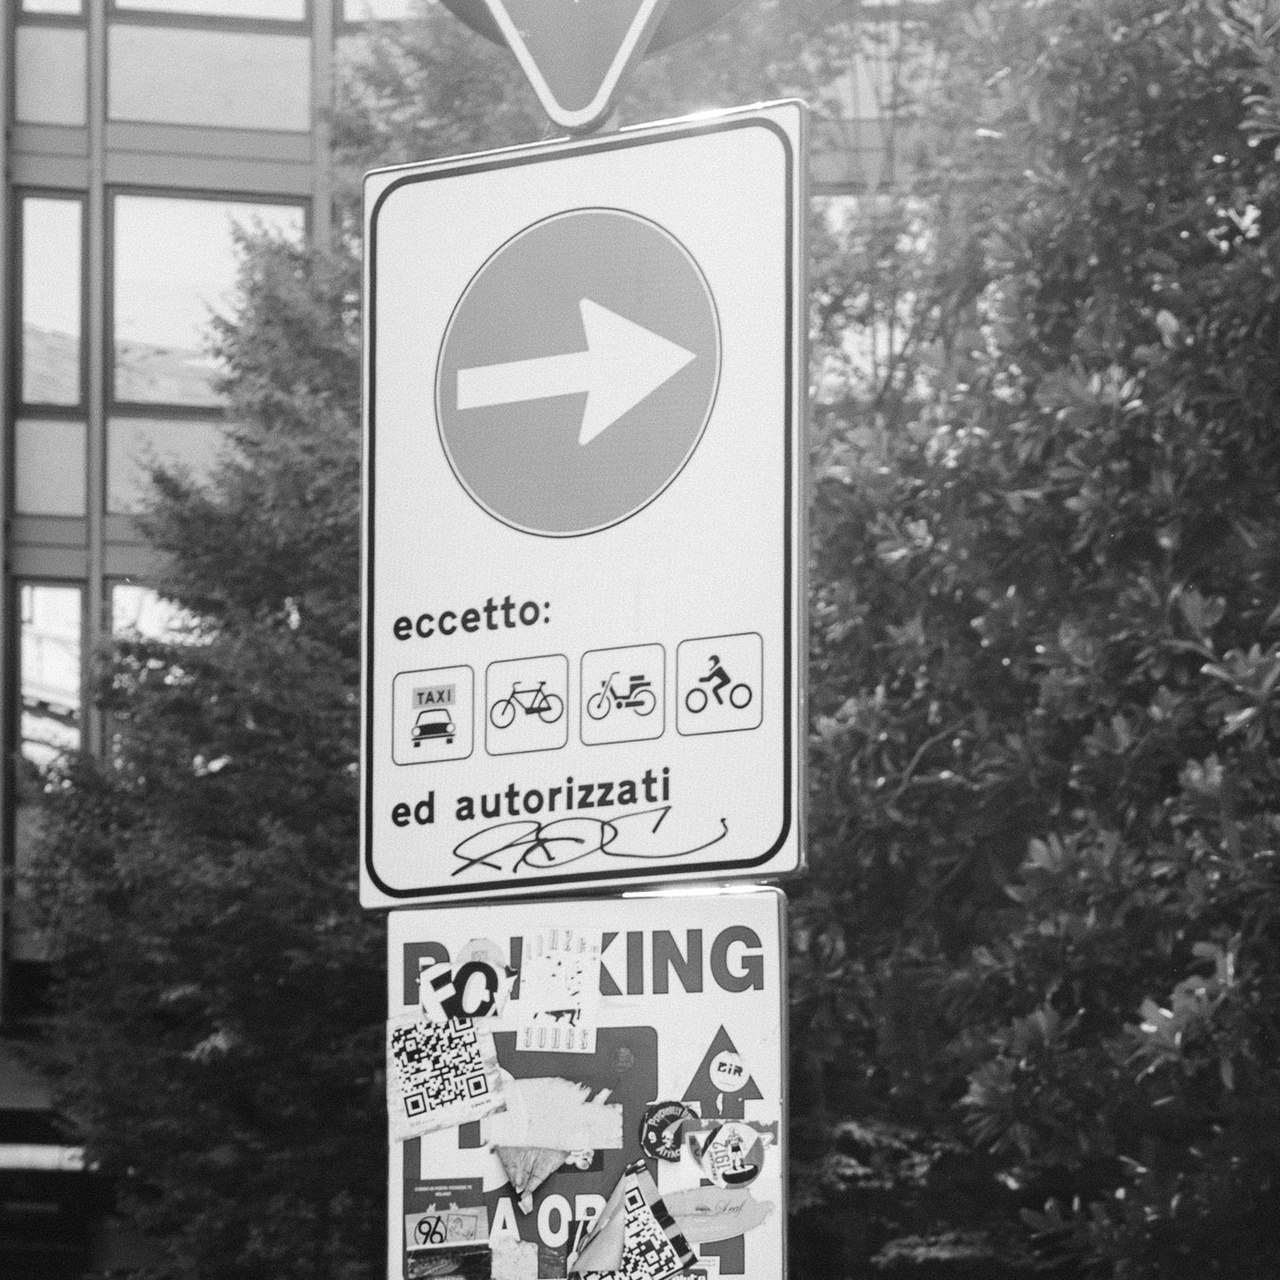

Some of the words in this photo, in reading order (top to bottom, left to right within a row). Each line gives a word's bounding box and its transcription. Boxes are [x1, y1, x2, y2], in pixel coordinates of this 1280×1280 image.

[392, 595, 551, 642] eccetto:
[416, 689, 451, 705] TAXI
[391, 791, 435, 828] ed
[455, 767, 671, 822] autorizzati
[403, 925, 764, 1006] PKING
